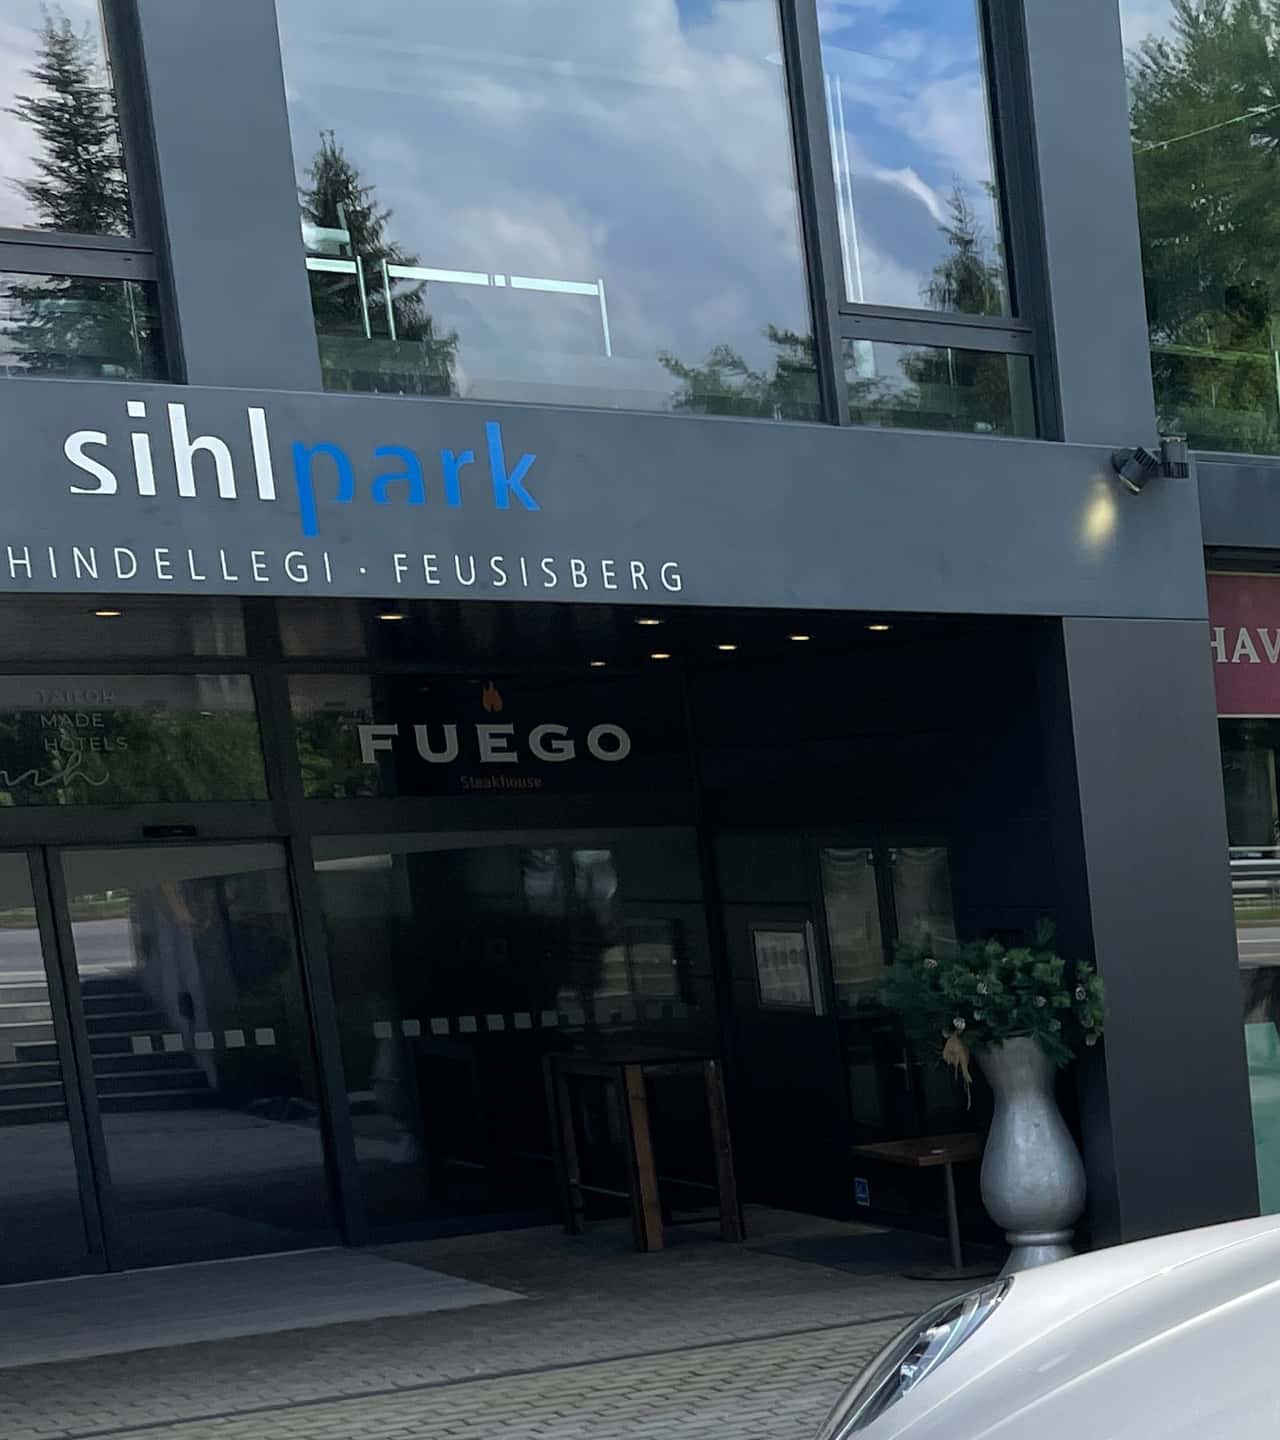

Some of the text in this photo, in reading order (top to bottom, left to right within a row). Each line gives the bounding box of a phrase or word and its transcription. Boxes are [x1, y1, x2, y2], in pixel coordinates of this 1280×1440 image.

[63, 400, 541, 537] sihlpark
[7, 546, 683, 592] HINDELLEGI FEUSISBERG
[40, 712, 105, 728] MADE
[44, 736, 129, 752] HOTELS
[357, 723, 632, 764] FUEGO
[460, 775, 542, 790] Steakhouse
